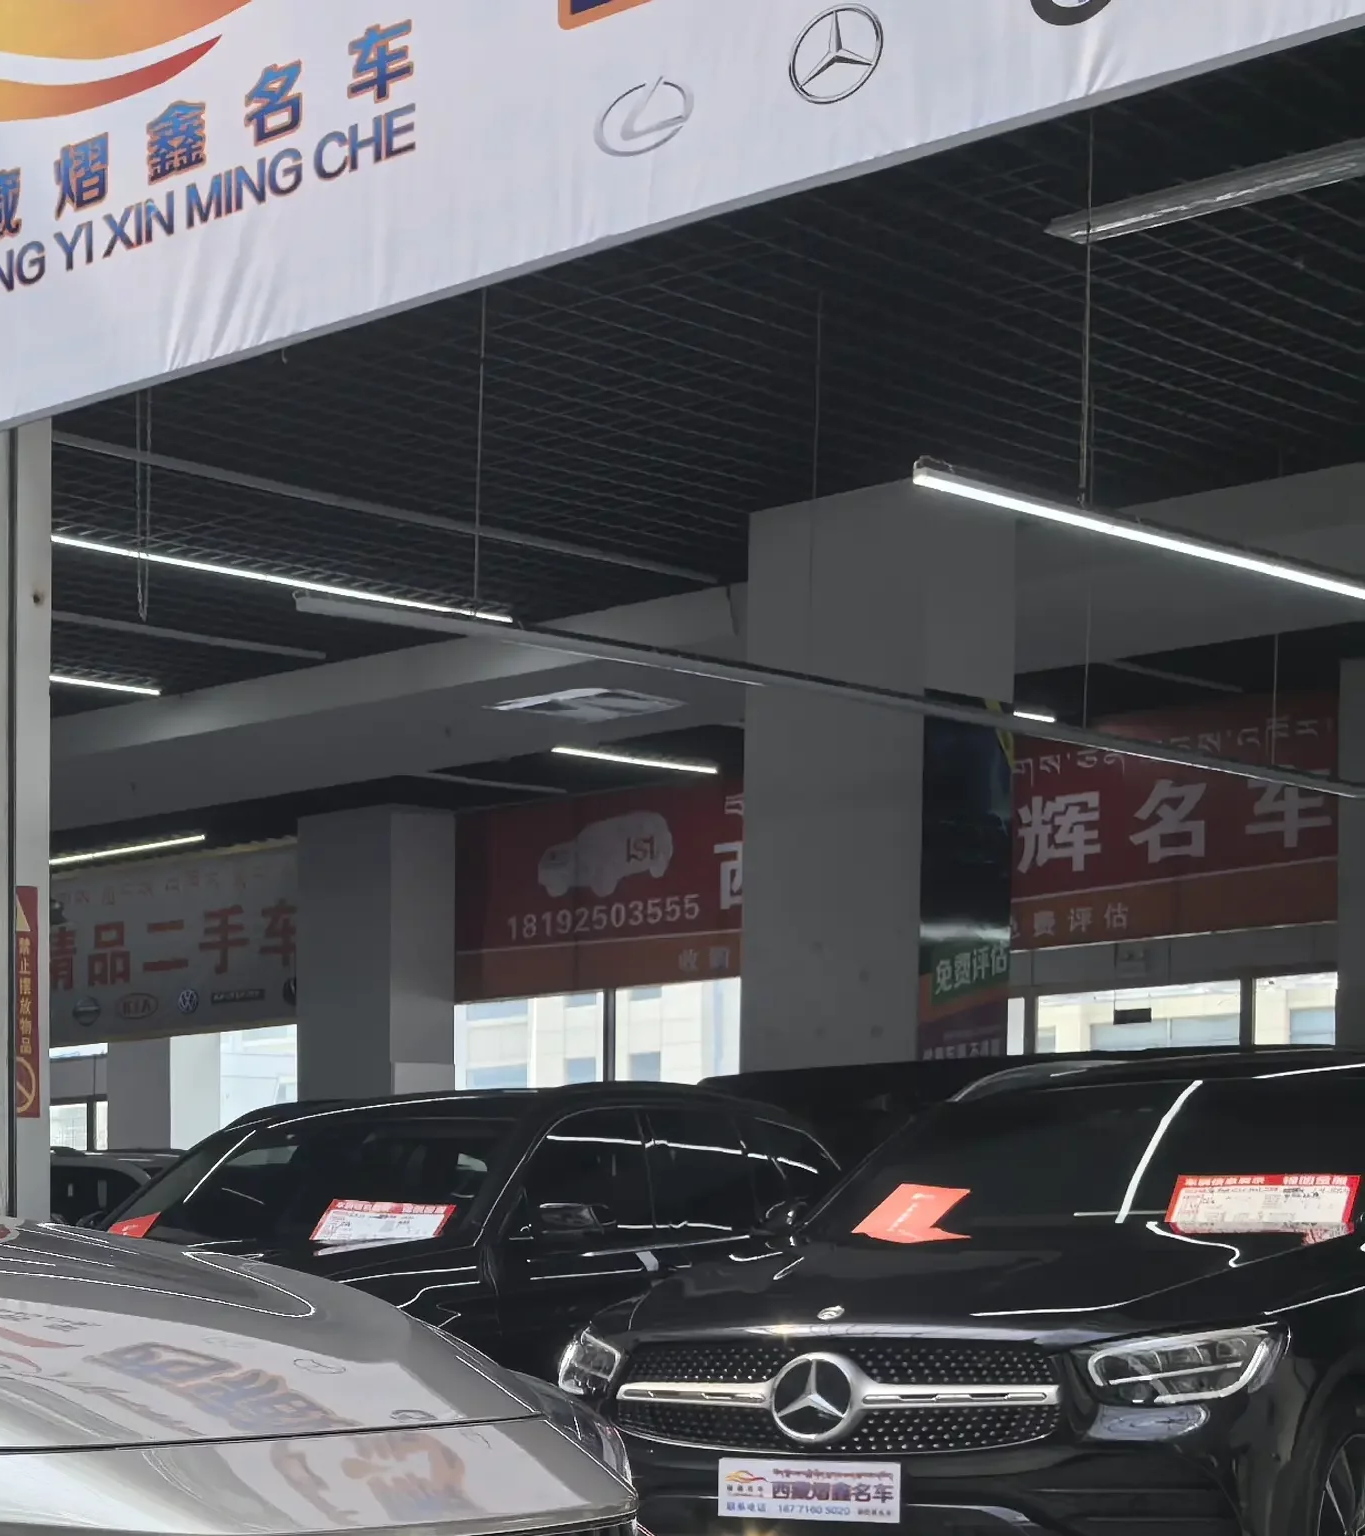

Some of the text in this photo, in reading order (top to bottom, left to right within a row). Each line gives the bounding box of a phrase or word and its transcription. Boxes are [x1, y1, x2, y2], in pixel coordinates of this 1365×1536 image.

[53, 219, 95, 273] YI
[101, 190, 175, 260] XIN
[185, 147, 303, 231] MING
[313, 102, 417, 182] CHE
[1017, 772, 1332, 874] 辉名车
[507, 893, 701, 942] 18192503555
